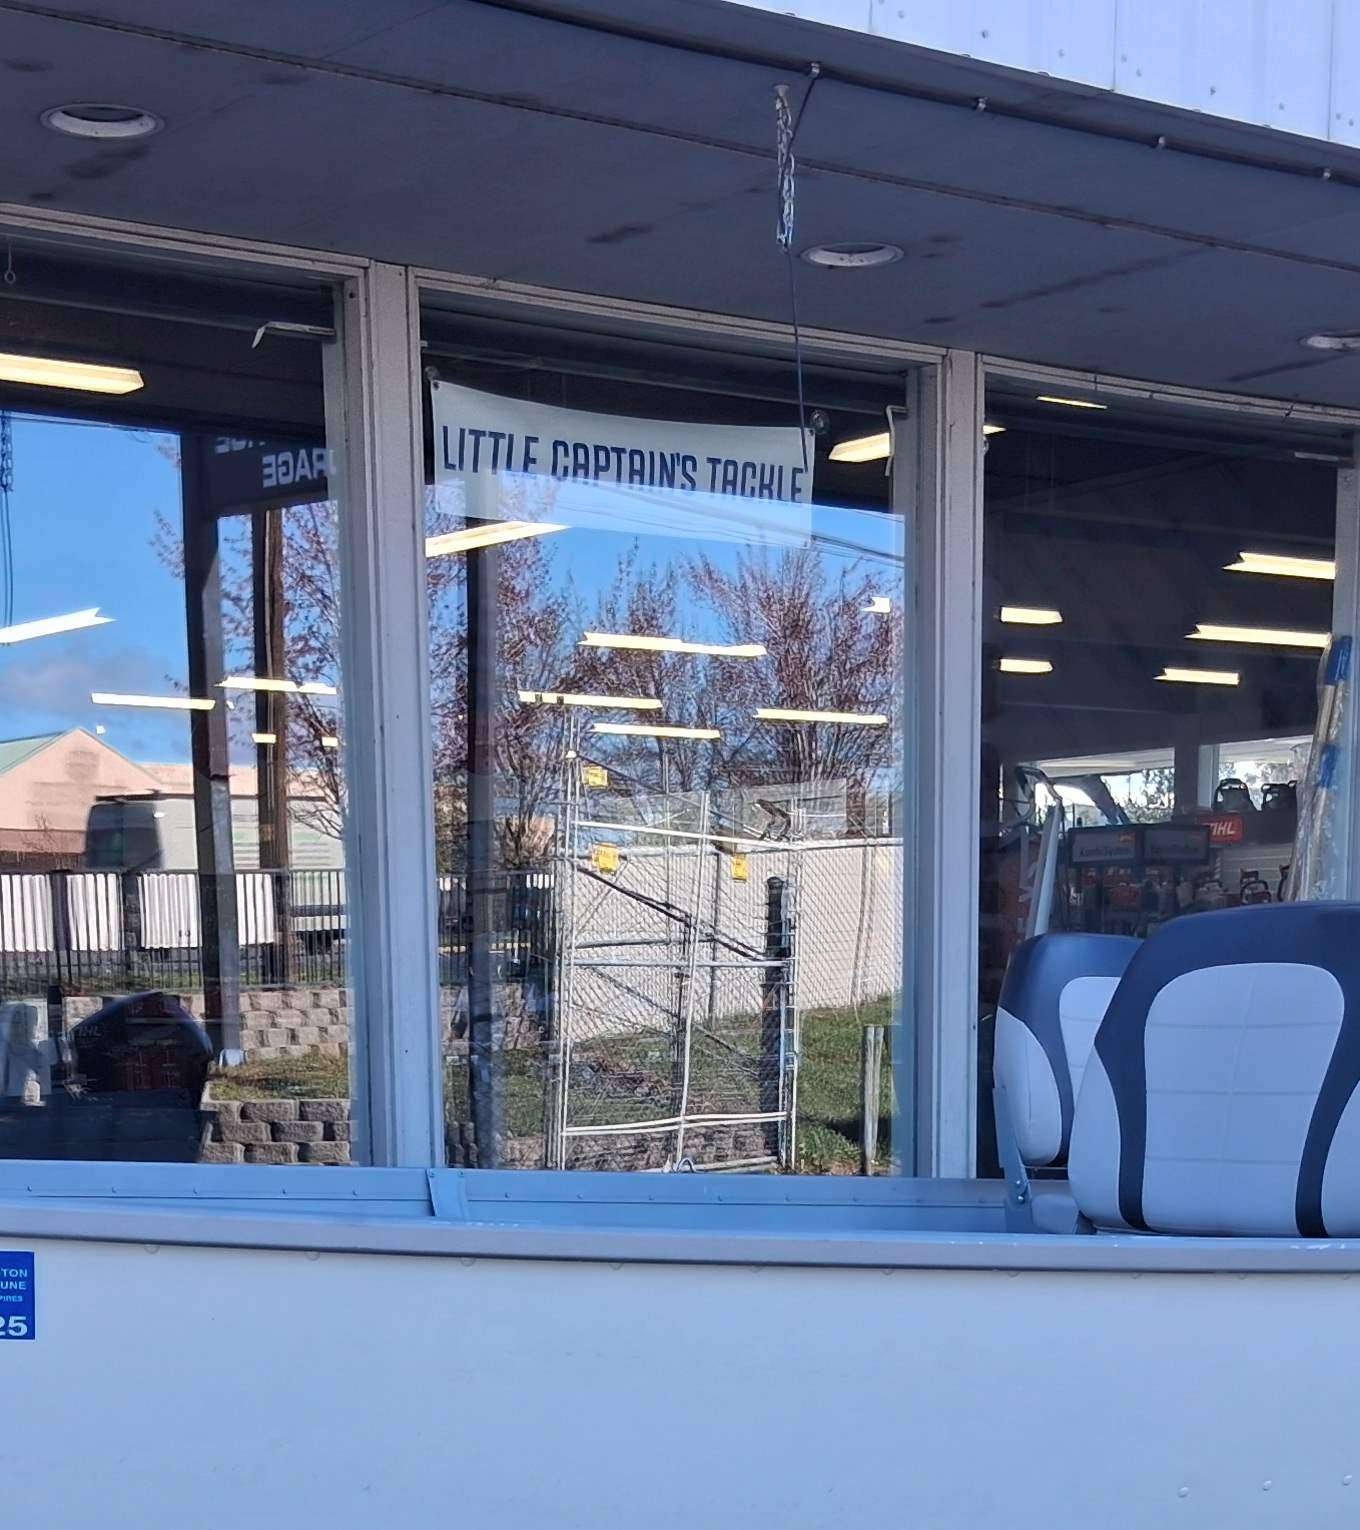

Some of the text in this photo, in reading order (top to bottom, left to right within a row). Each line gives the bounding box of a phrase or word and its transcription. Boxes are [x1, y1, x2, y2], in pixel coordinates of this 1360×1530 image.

[442, 425, 805, 504] LITTLE CAPTAIN'S TACKLE
